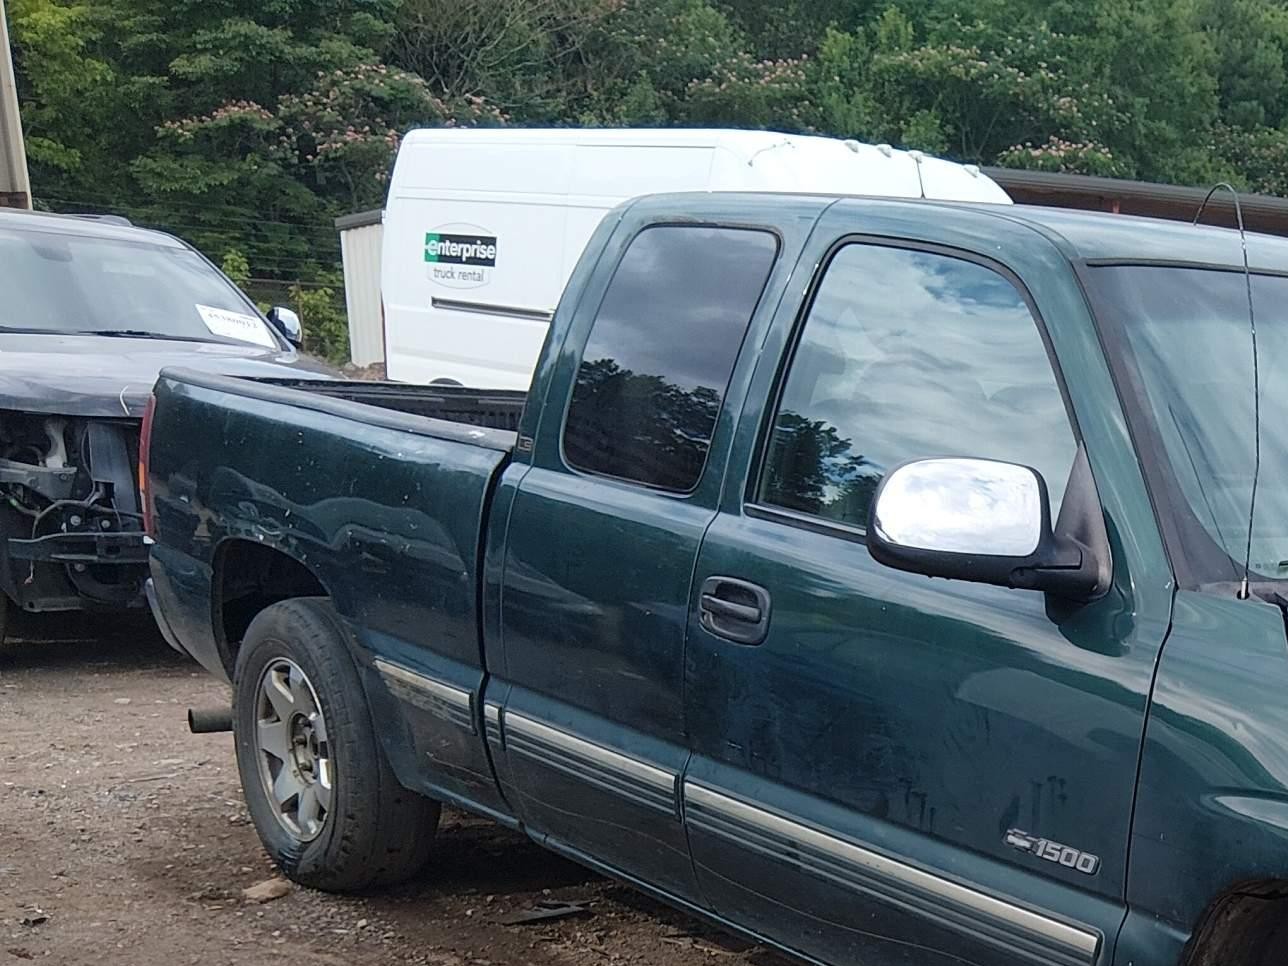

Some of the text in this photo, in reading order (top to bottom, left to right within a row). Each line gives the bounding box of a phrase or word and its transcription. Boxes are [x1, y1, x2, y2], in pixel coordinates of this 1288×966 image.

[426, 239, 495, 262] enterprise
[433, 266, 484, 282] truck rental
[1035, 837, 1099, 874] 1500
